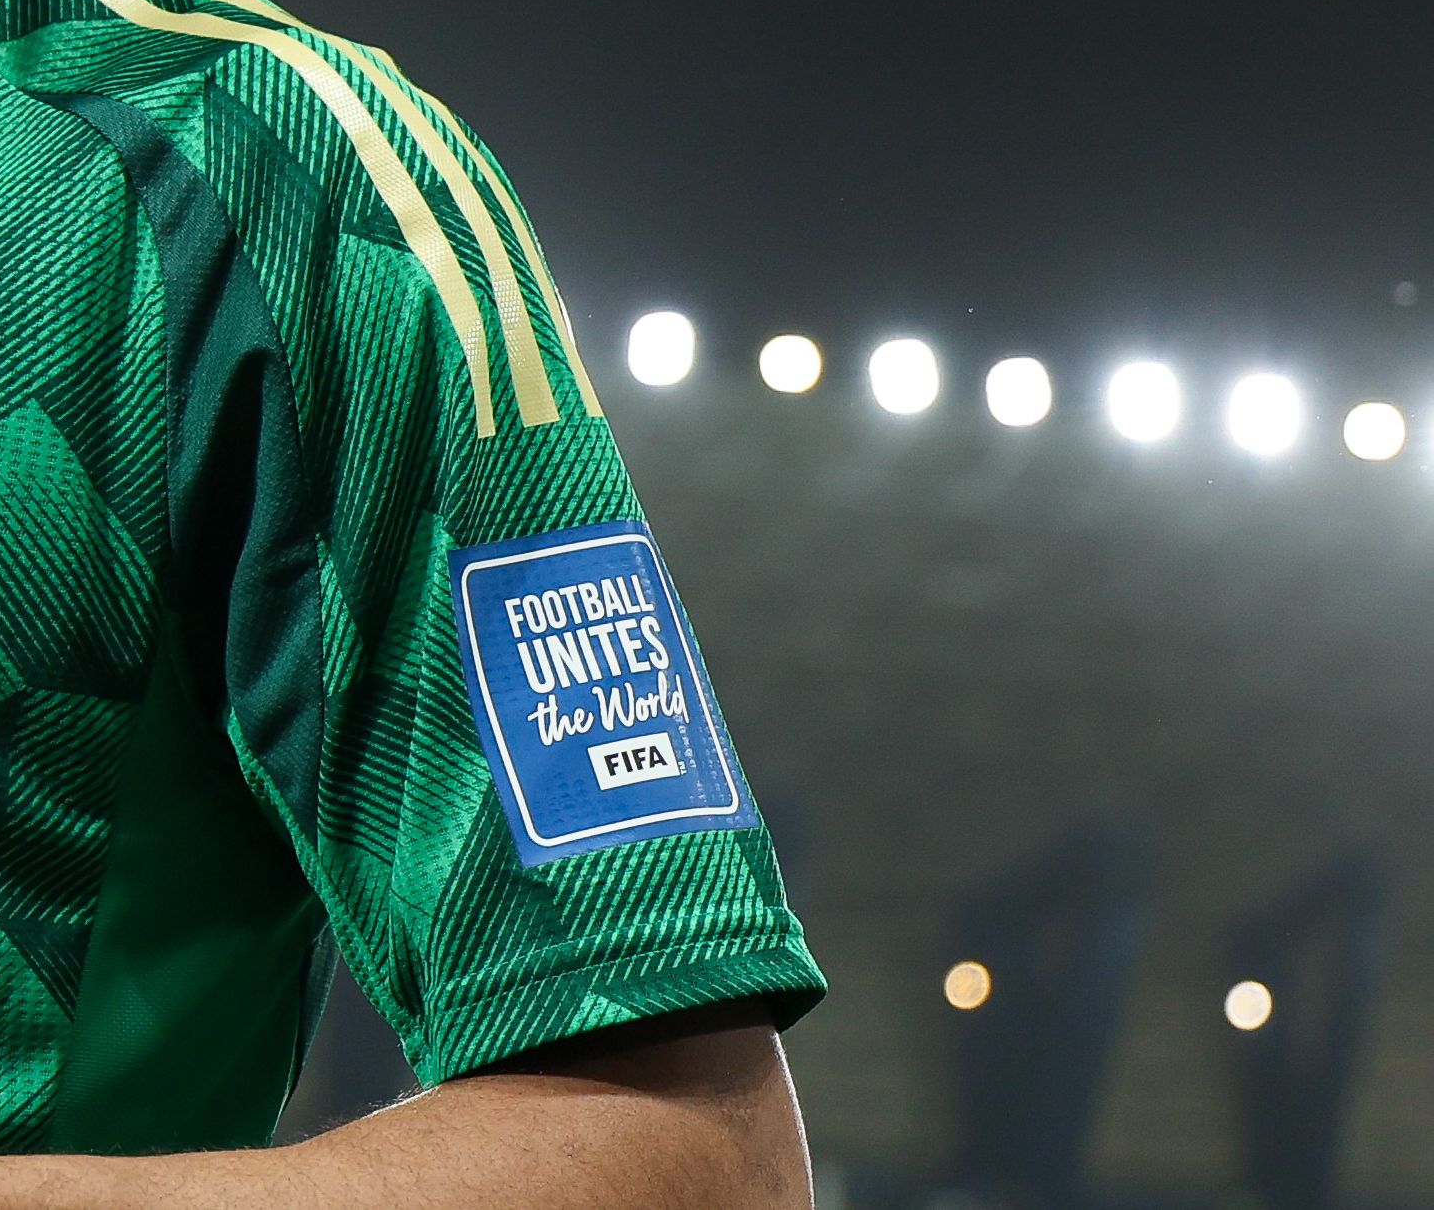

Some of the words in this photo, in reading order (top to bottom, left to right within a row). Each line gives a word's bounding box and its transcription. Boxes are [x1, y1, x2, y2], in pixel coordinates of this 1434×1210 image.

[504, 574, 655, 638] FOOTBALL
[516, 615, 671, 694] UNITES
[527, 694, 595, 746] the
[591, 670, 690, 732] World
[604, 745, 668, 776] FIFA
